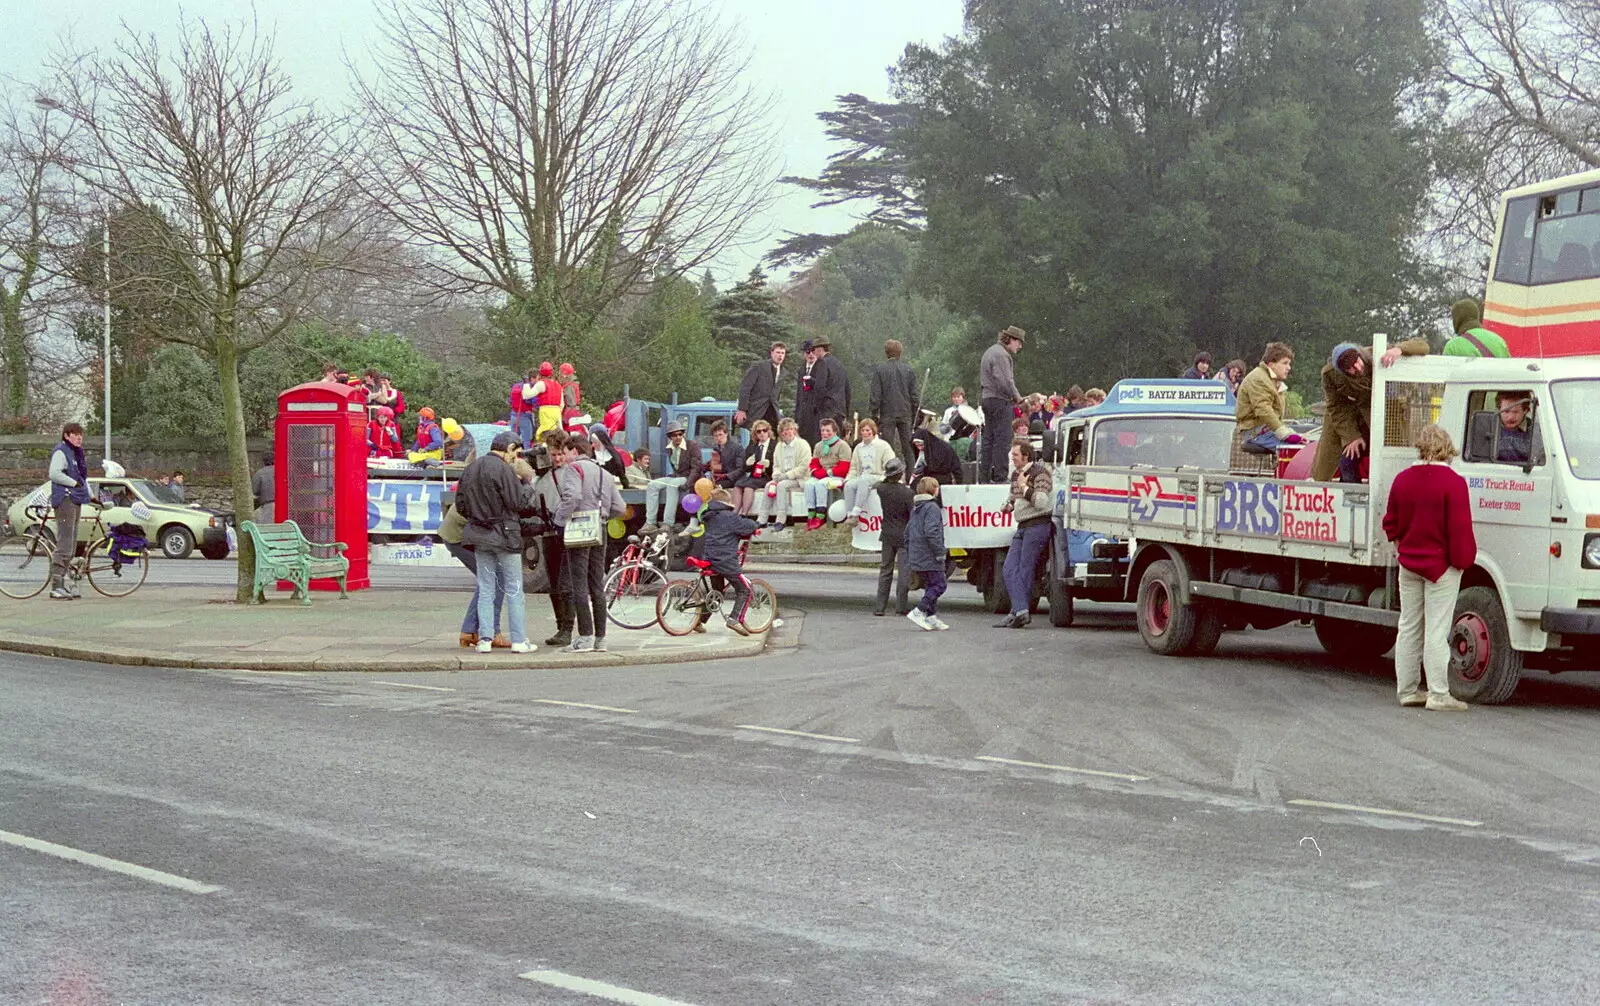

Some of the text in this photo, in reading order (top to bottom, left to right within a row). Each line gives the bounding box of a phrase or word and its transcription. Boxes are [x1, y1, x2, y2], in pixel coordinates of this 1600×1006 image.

[1148, 390, 1177, 400] BAYLY
[1178, 390, 1226, 400] BARTLETT
[1469, 477, 1535, 492] BRS Truck Rental
[1217, 481, 1335, 536] BRS Truck
[1479, 498, 1503, 509] Exeter
[1283, 511, 1337, 543] Rental
